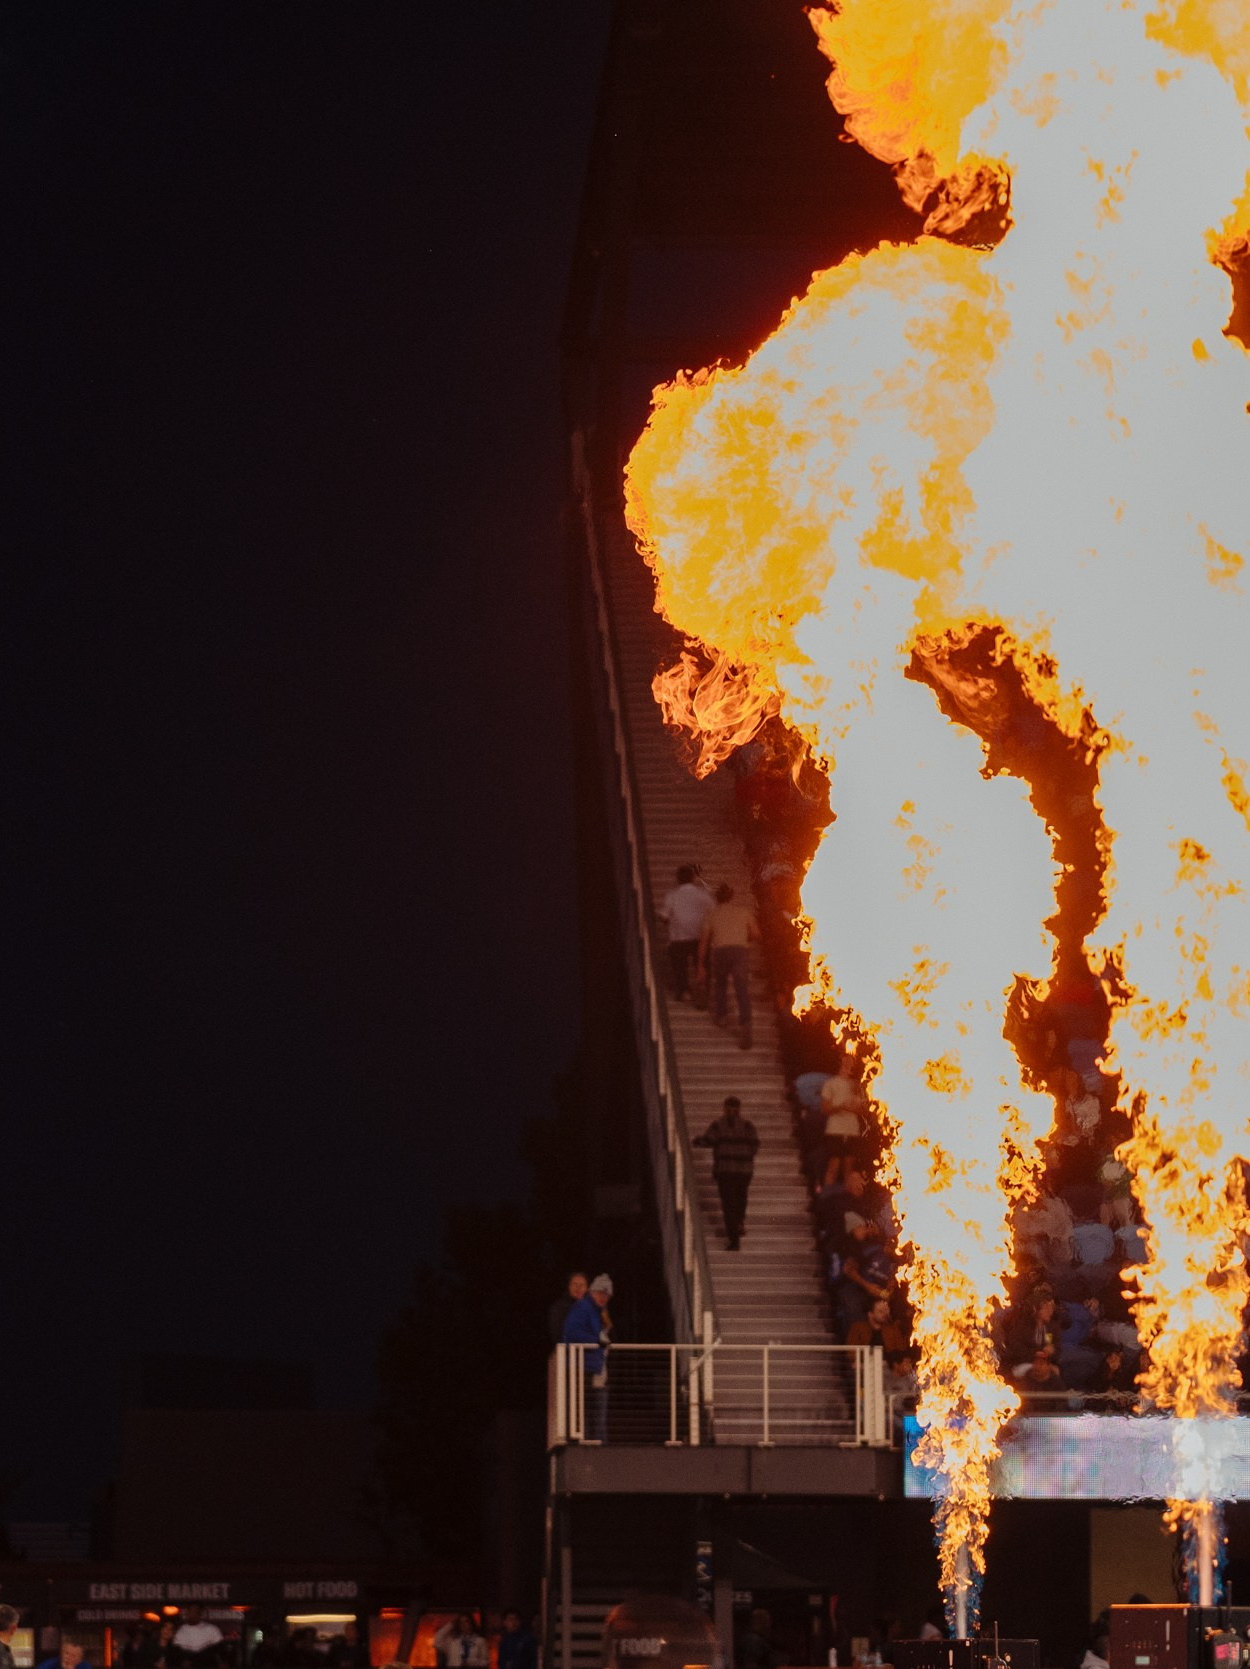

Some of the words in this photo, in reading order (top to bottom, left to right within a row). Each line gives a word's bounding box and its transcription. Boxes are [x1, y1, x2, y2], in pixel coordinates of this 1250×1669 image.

[89, 1583, 127, 1600] EAST
[130, 1583, 164, 1600] SIDE
[167, 1583, 230, 1600] MARKET
[284, 1581, 314, 1598] HOT
[317, 1581, 358, 1598] FOOD
[621, 1638, 661, 1656] FOOD
